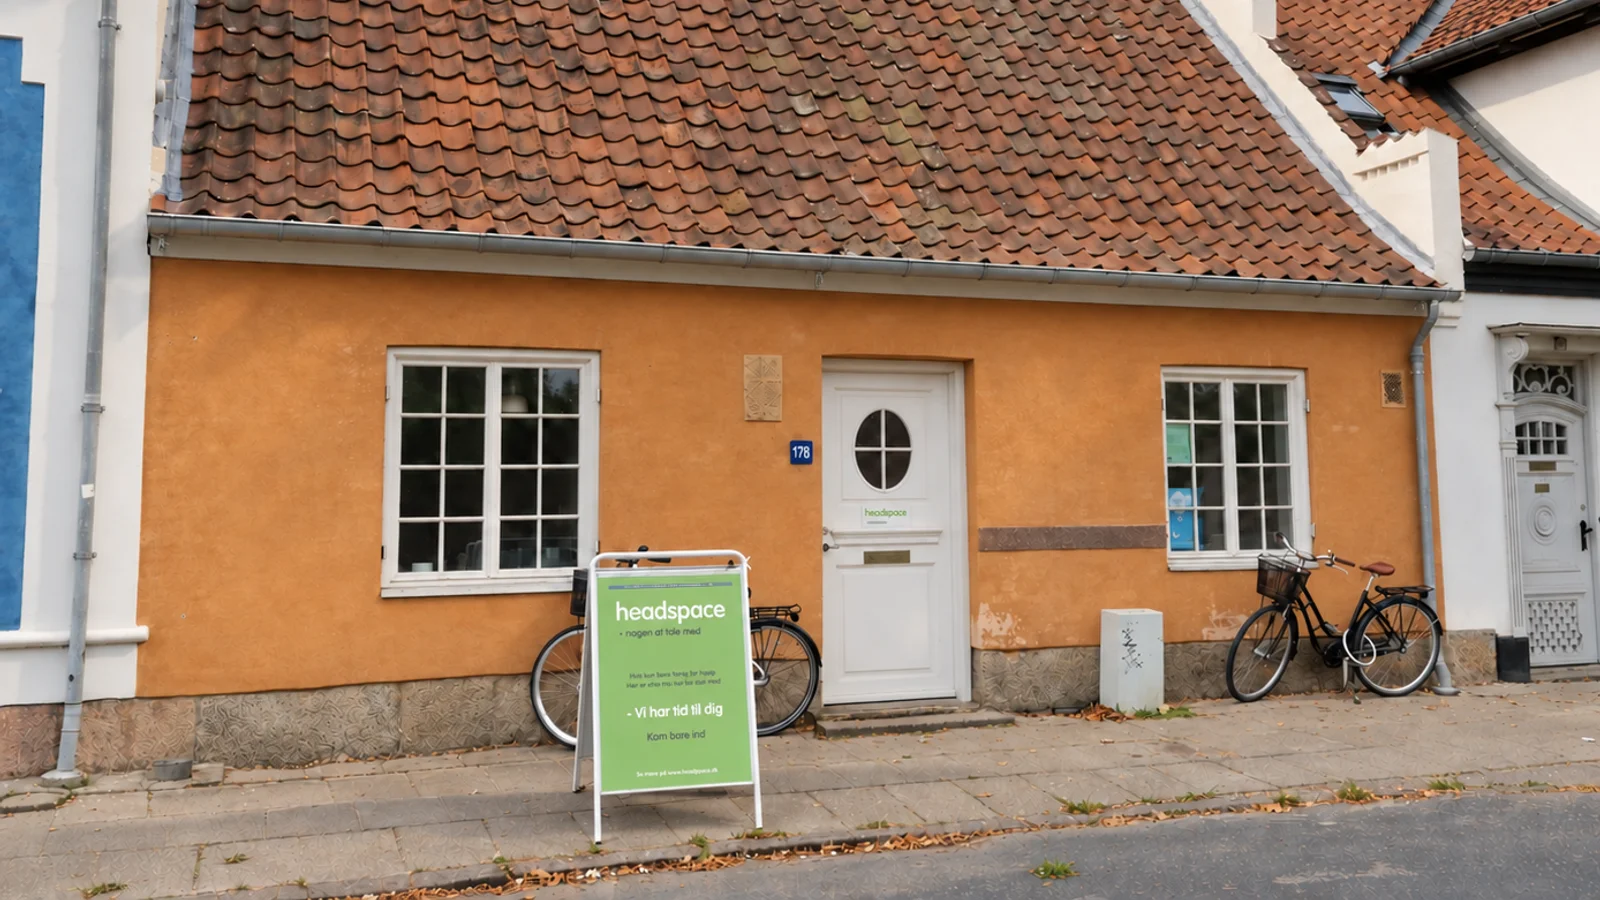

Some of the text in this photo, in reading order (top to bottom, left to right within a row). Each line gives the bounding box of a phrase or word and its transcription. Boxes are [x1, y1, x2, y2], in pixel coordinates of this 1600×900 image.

[792, 446, 811, 459] 178
[864, 507, 907, 519] headspace
[615, 600, 726, 625] headspace
[625, 630, 653, 640] nogen
[654, 628, 663, 637] at
[682, 626, 701, 636] med
[634, 707, 647, 719] Vi
[649, 705, 671, 718] har
[672, 704, 688, 717] tid
[690, 703, 701, 716] til
[704, 702, 723, 717] dig
[646, 729, 706, 742] Kom bare ind
